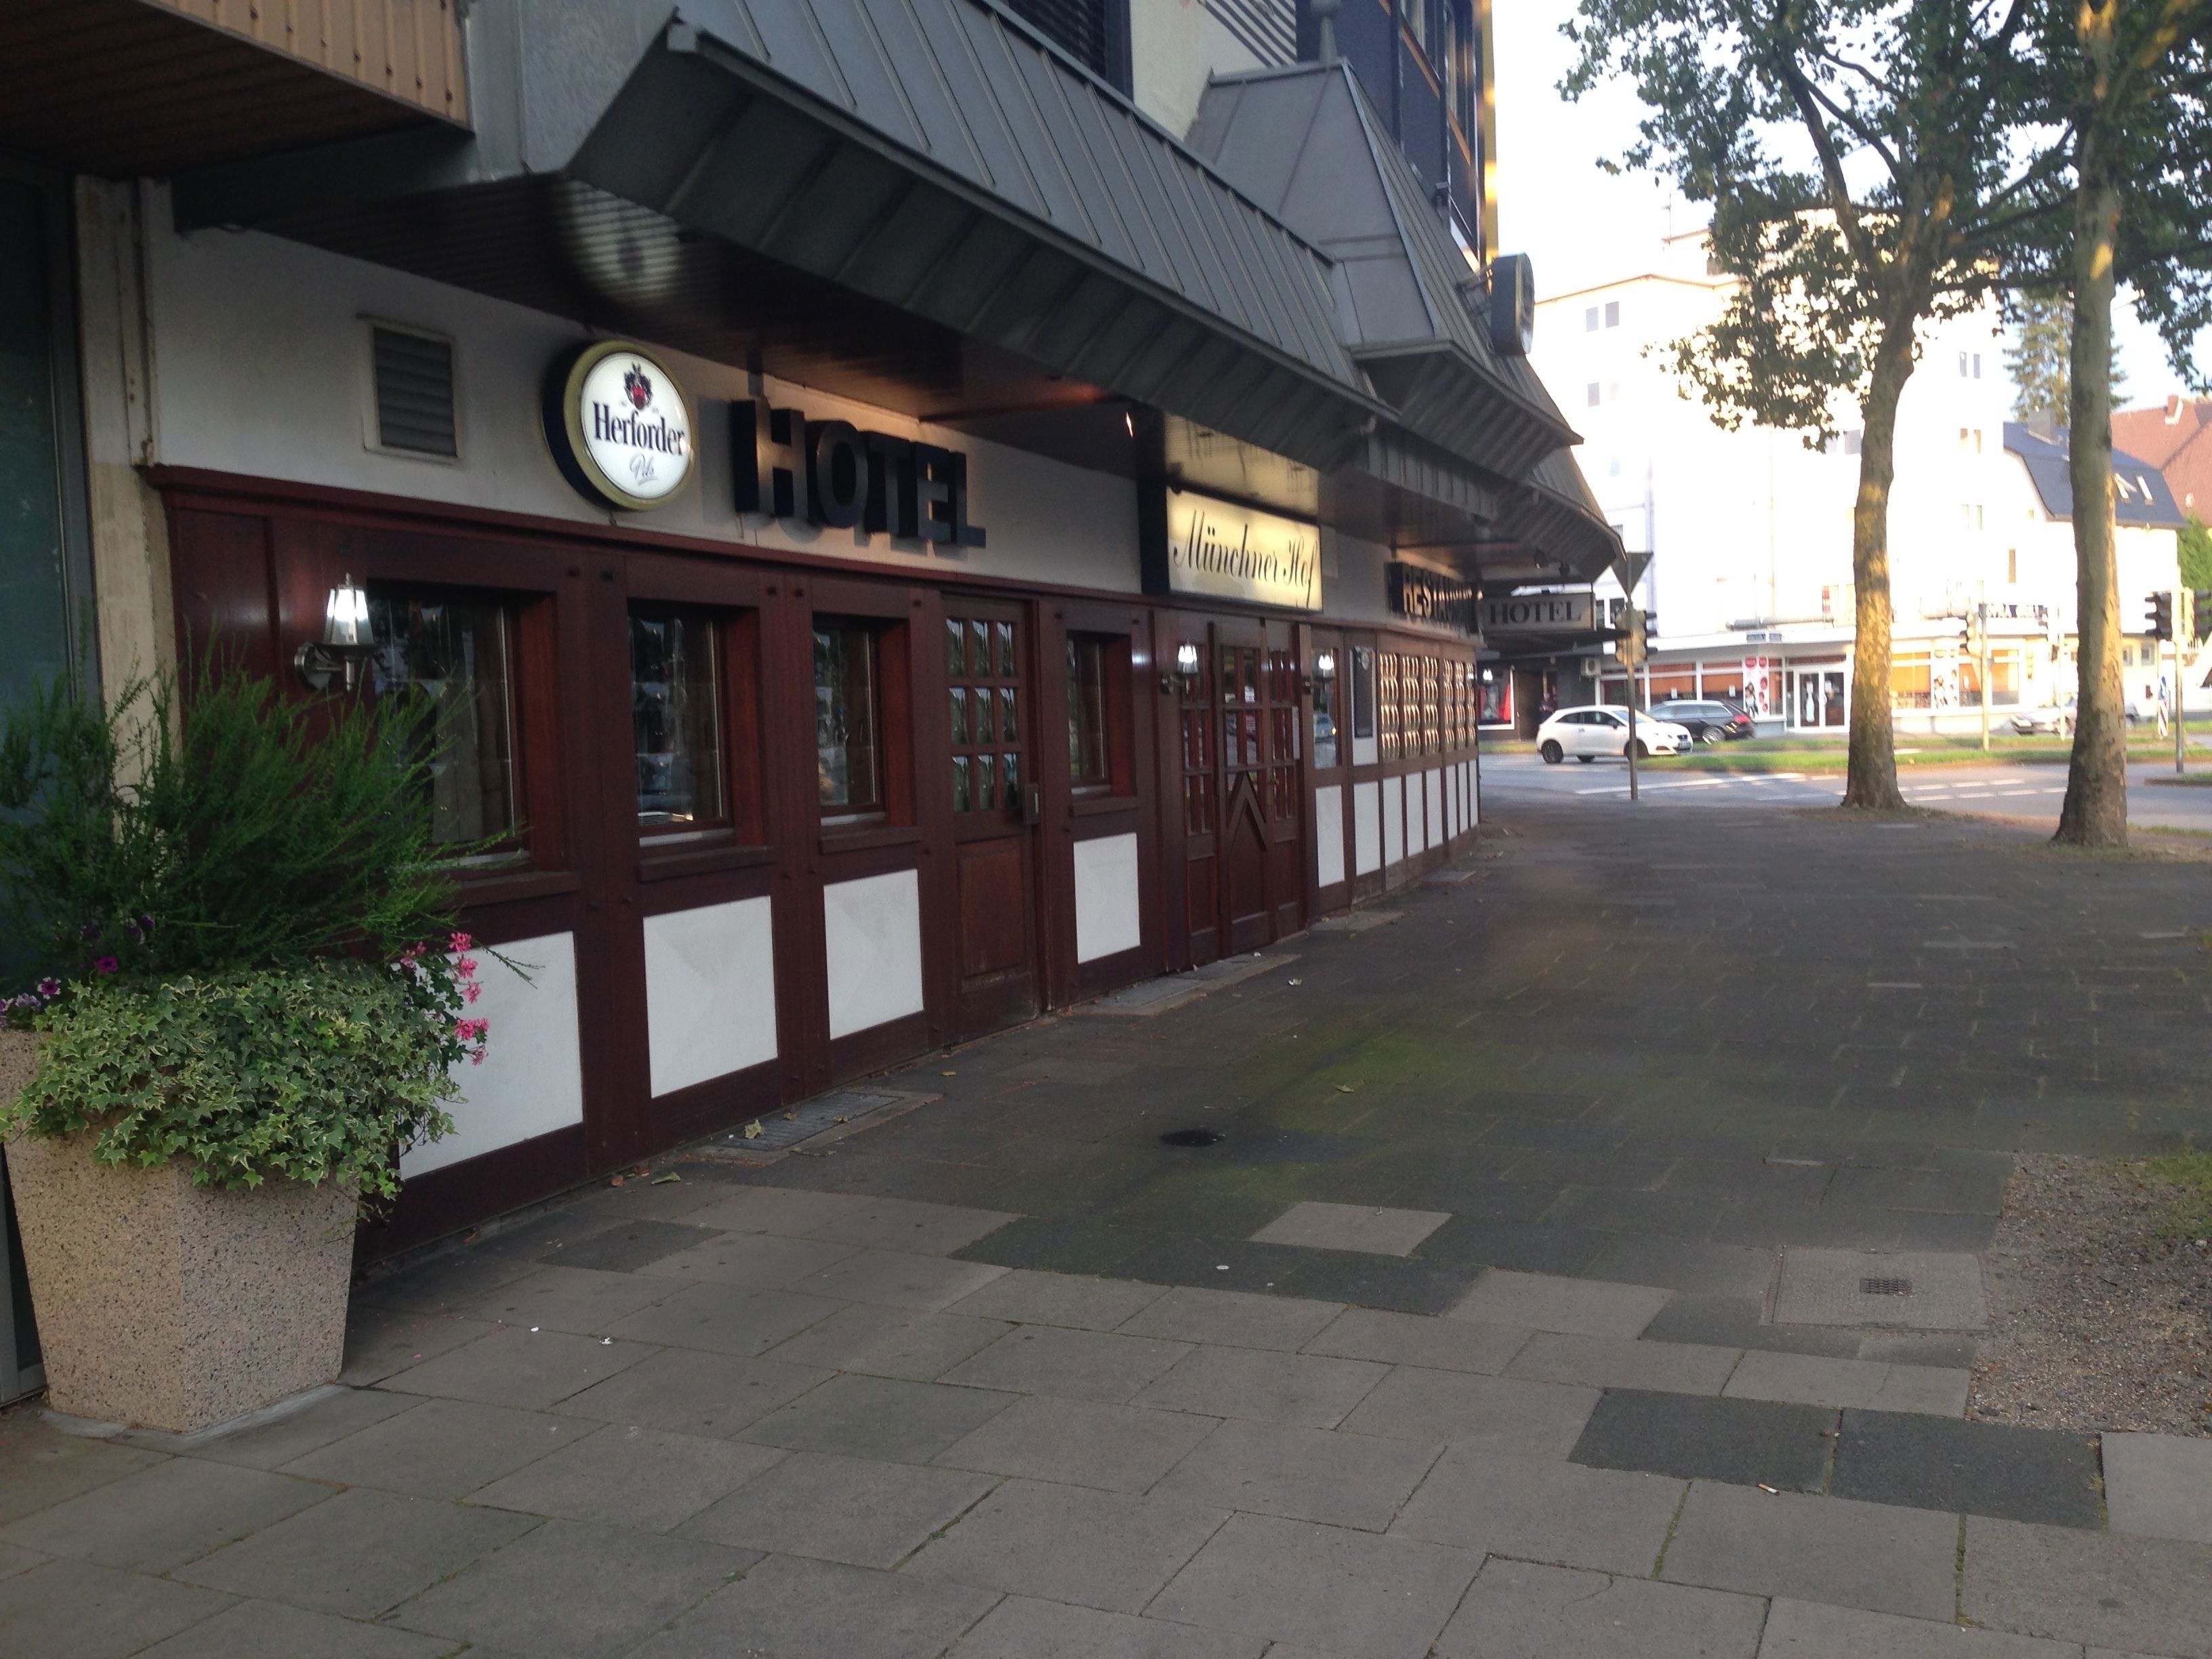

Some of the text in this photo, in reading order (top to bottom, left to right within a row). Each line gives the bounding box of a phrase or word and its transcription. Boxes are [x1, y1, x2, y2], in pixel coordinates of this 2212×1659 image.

[593, 401, 684, 456] Herforder
[731, 398, 987, 549] HOTEL
[1173, 509, 1319, 609] Münchner Hof
[1489, 600, 1582, 624] HOTEL
